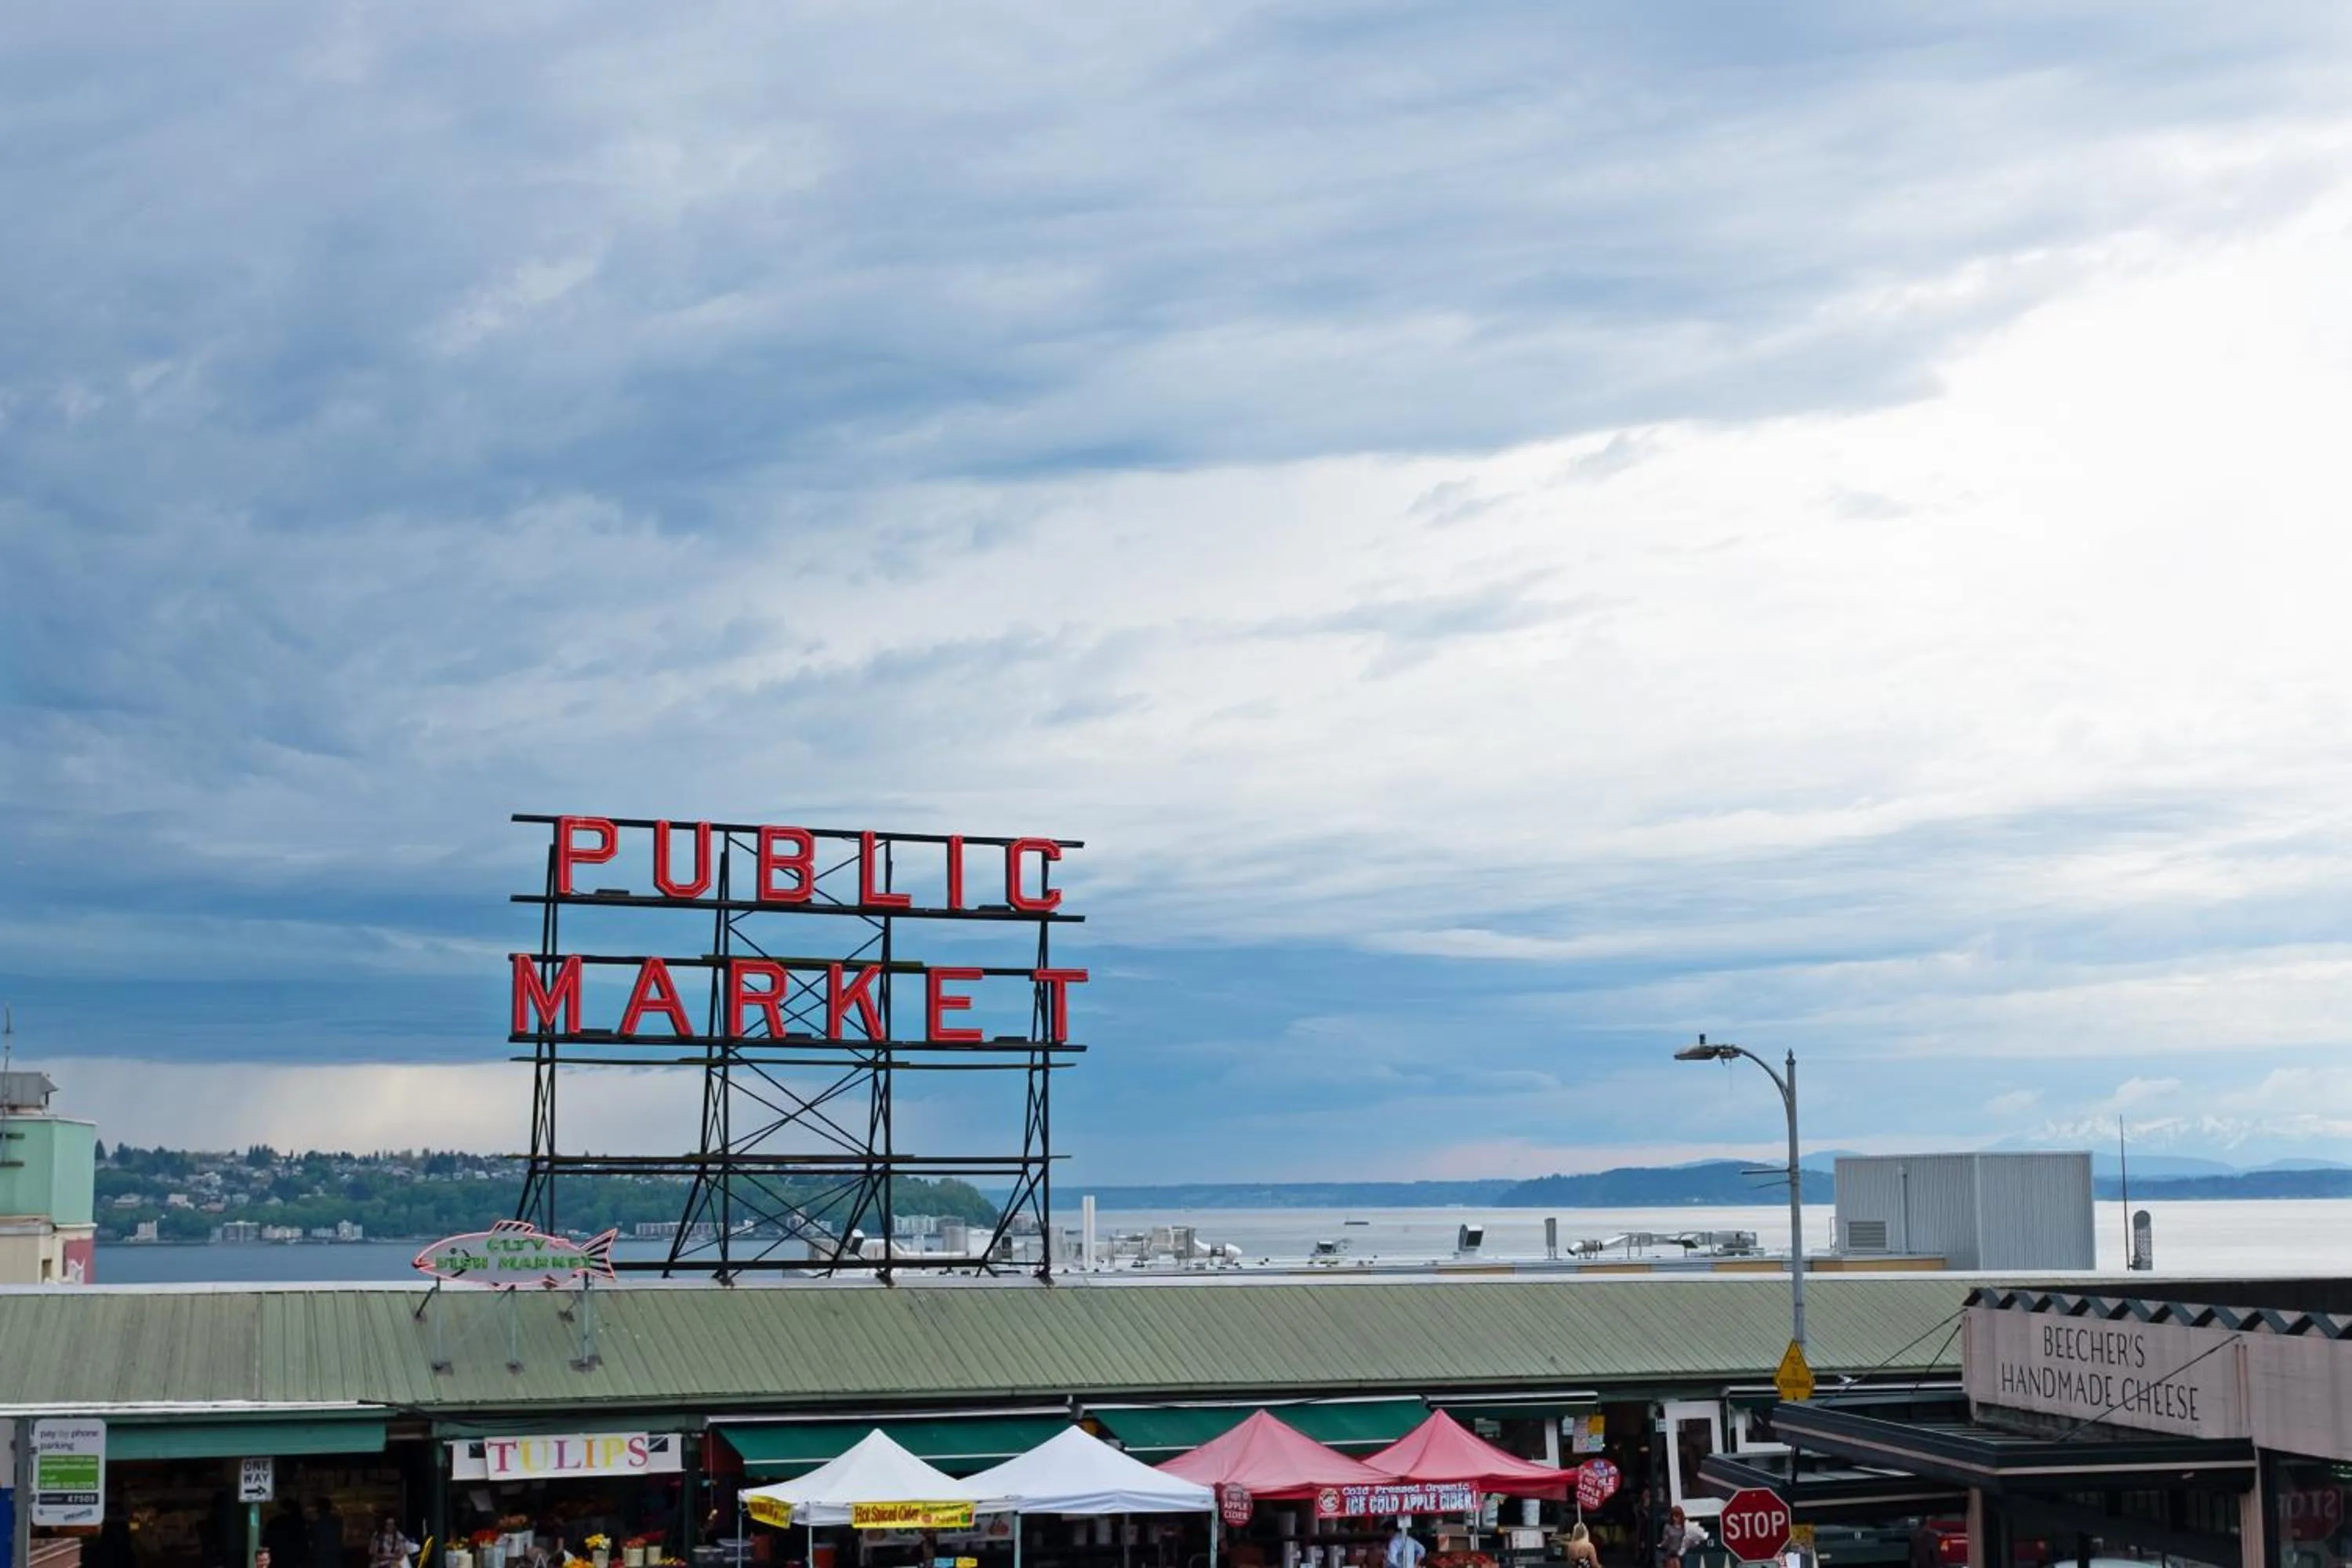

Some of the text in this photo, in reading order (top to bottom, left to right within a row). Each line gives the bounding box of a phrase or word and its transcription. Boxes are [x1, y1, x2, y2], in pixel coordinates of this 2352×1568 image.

[556, 816, 1062, 913] PUBLIC
[512, 954, 1088, 1044] MARKET
[487, 1239, 546, 1252] CITY
[498, 1256, 592, 1269] MARKET
[2044, 1325, 2145, 1368] BEECHER'S
[2002, 1362, 2199, 1421] HANDMADE CHEESE
[40, 1431, 56, 1439] pay
[71, 1428, 99, 1439] phone
[40, 1442, 74, 1452] parking
[488, 1436, 648, 1472] TULIPS
[245, 1460, 269, 1472] ONE
[245, 1473, 269, 1483] WAY
[1225, 1501, 1247, 1510] APPLE
[1345, 1497, 1365, 1515] ICE
[1370, 1495, 1399, 1513] COLD
[1403, 1493, 1436, 1512] APPLE
[1440, 1490, 1477, 1511] CIDER!
[854, 1505, 869, 1523] Hot
[872, 1504, 897, 1525] Spiced
[898, 1504, 920, 1520] Cider
[1224, 1511, 1249, 1520] CIDER
[1726, 1512, 1785, 1540] STOP
